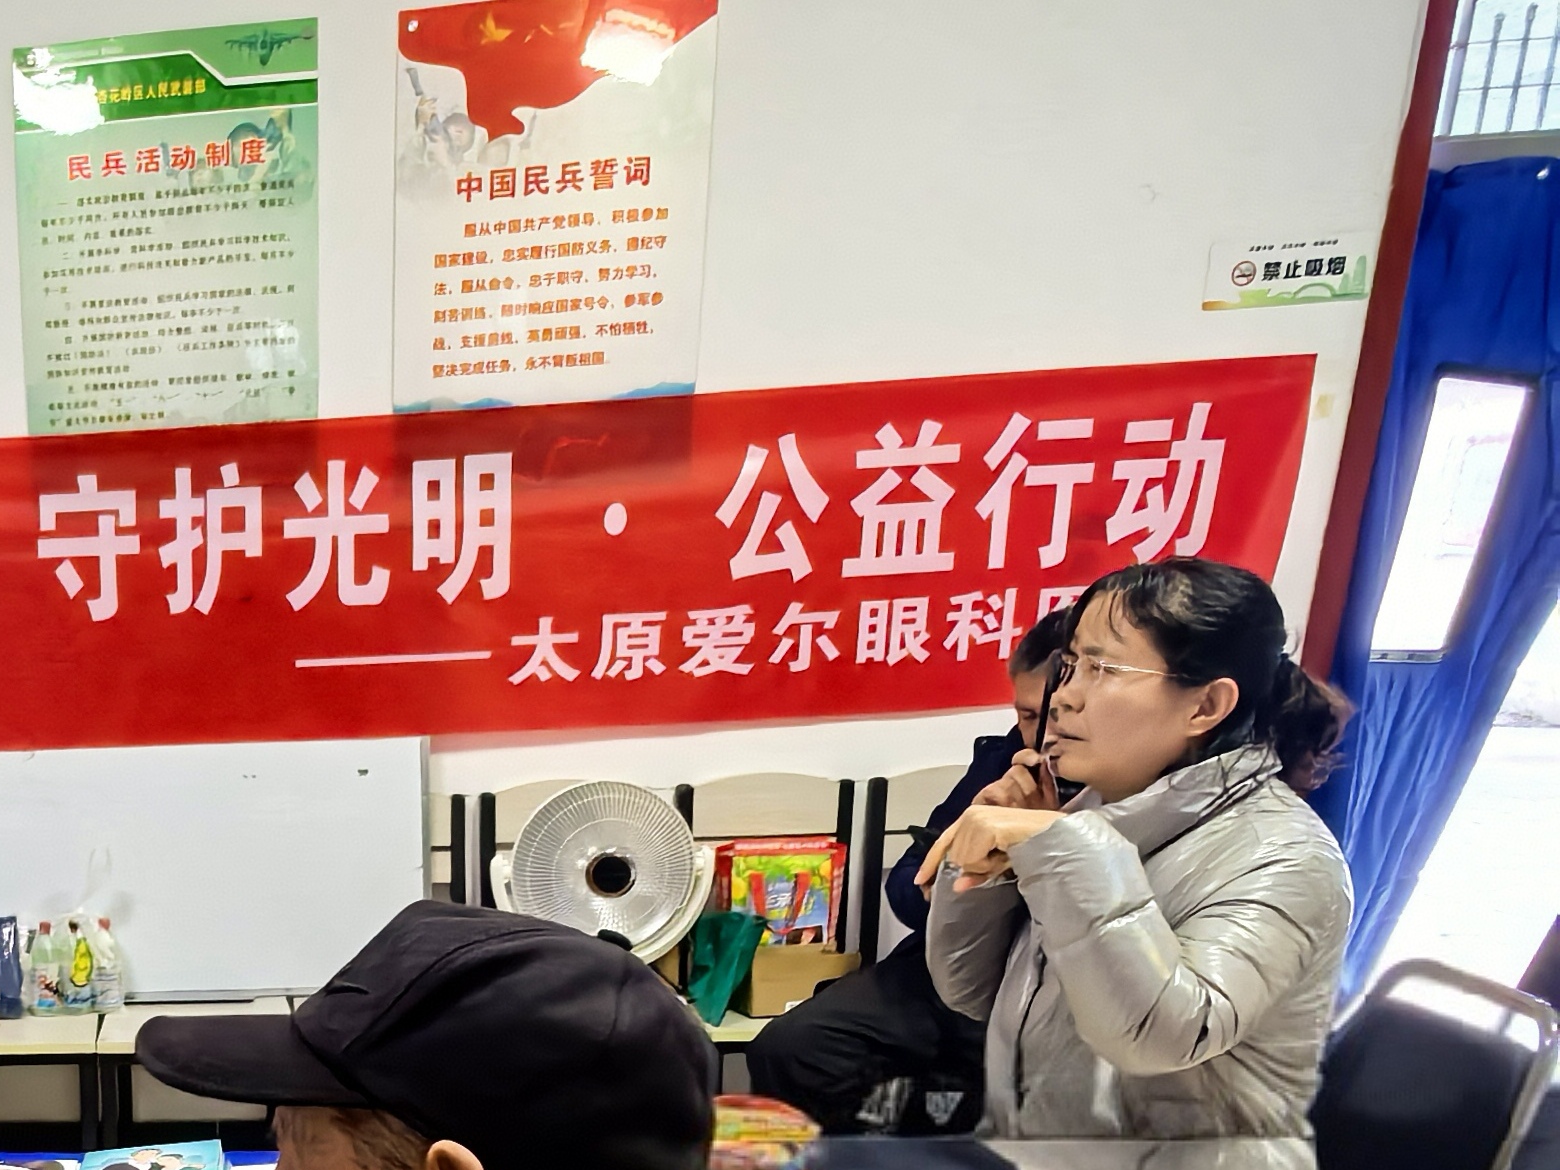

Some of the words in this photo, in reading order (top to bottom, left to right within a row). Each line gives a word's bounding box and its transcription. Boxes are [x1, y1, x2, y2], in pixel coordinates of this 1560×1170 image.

[67, 137, 267, 180] 民兵活动制度
[457, 156, 651, 202] 中国民兵誓词
[1261, 255, 1347, 281] 禁止吸烟
[715, 401, 1227, 585] 公益行动
